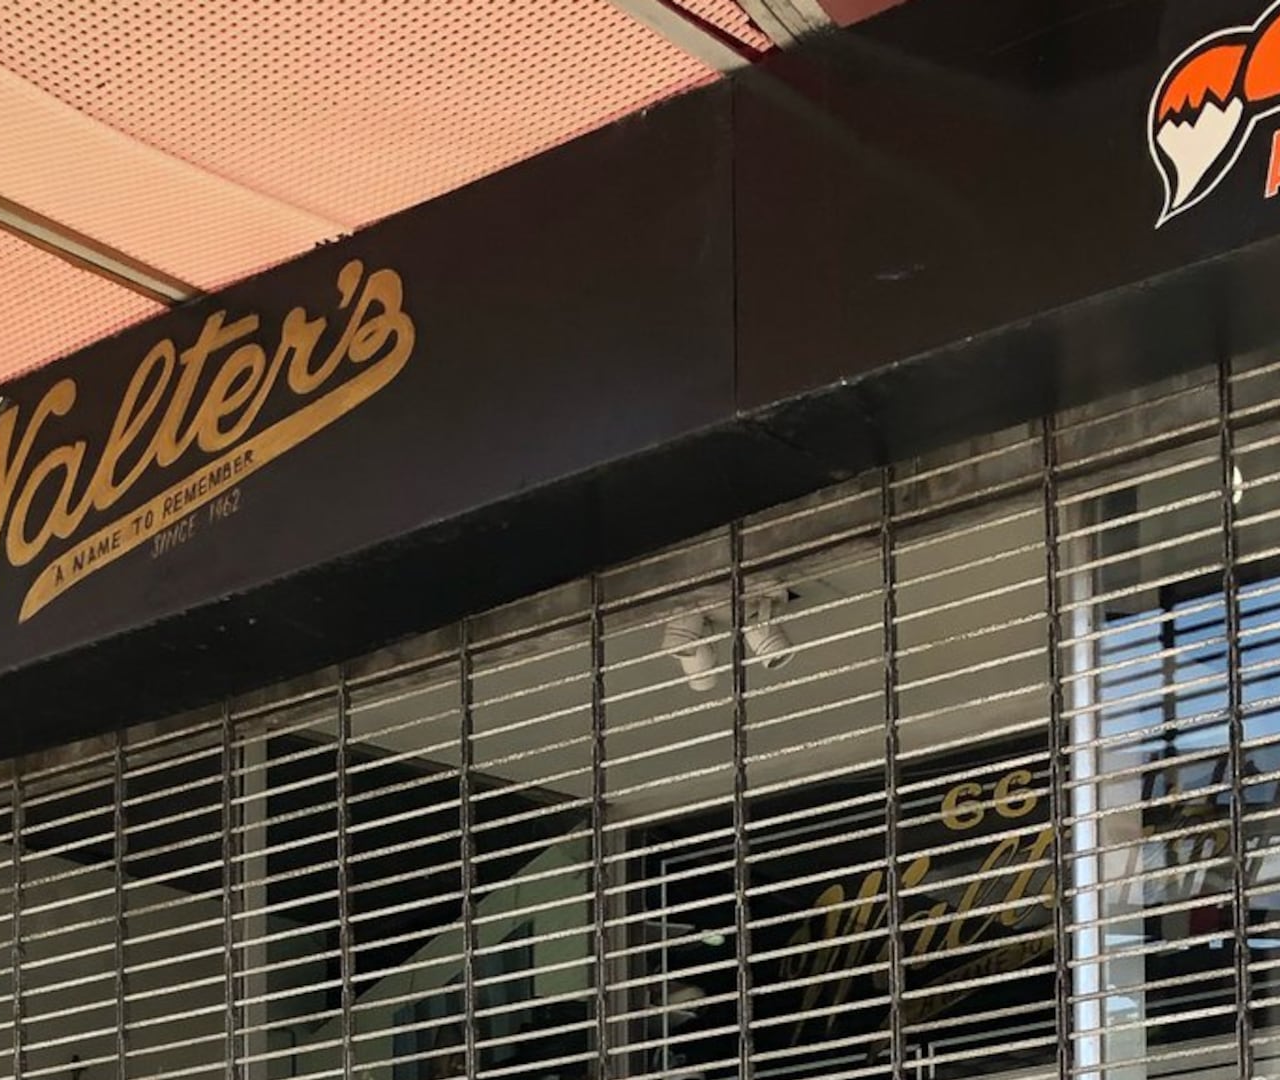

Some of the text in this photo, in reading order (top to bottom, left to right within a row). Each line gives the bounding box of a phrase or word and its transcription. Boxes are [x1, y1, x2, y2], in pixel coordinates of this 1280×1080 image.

[53, 449, 254, 587] A NAME TO REMEMBER
